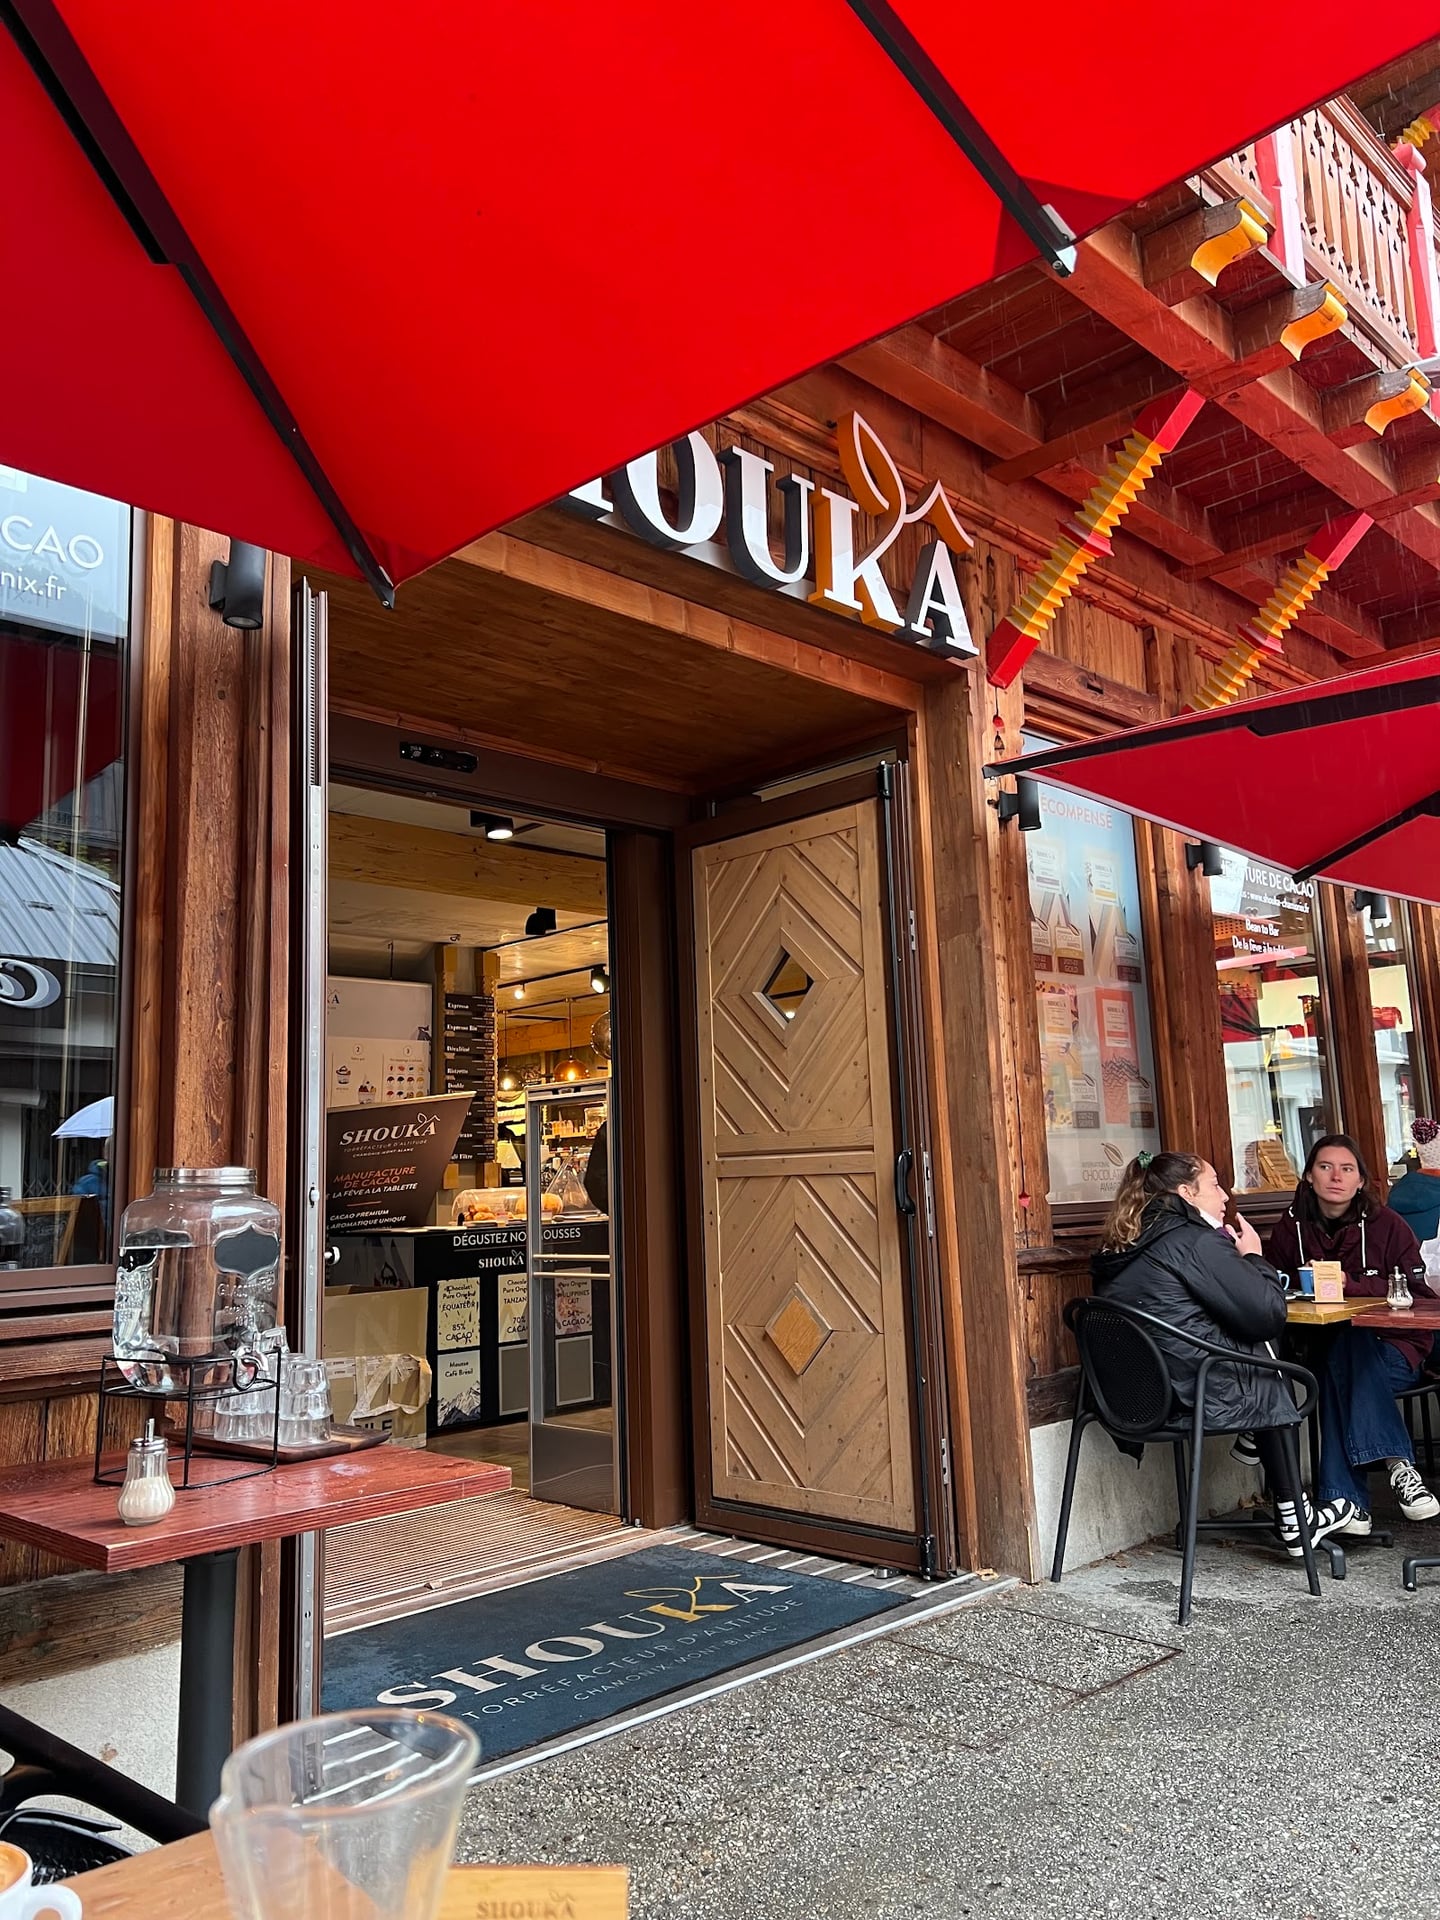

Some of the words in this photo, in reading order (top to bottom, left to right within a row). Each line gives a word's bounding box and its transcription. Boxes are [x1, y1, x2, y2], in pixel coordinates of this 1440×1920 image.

[560, 411, 980, 659] OUKA
[1040, 793, 1113, 829] ÉCOMPENSÉ
[1269, 871, 1282, 890] DE
[1283, 876, 1314, 899] CACAO
[1245, 919, 1260, 933] Bean
[1261, 924, 1269, 935] to
[1269, 923, 1280, 936] Bar
[1232, 935, 1242, 949] De
[1243, 937, 1249, 950] la
[340, 1117, 438, 1146] SHOUKA
[333, 1166, 416, 1183] MANUFACTURE
[344, 1180, 359, 1189] DE
[361, 1176, 400, 1187] CACAO
[383, 1182, 418, 1192] TABLETTE
[330, 1213, 355, 1221] CACAO
[355, 1209, 390, 1218] PREMIUM
[330, 1219, 378, 1229] AROMATIQUE
[378, 1215, 407, 1224] UNIQUE
[453, 1232, 508, 1246] DÉGUSTEZ
[510, 1231, 527, 1243] NO
[543, 1227, 581, 1240] OUSSES
[478, 1252, 524, 1268] SHOUKA
[507, 1325, 528, 1333] CACA
[562, 1318, 585, 1327] CACAO
[446, 1332, 473, 1341] CACAO
[677, 1599, 803, 1645] D'ALTITUDE
[377, 1575, 794, 1712] SHOUKA
[476, 1895, 576, 1919] SHOUKA
